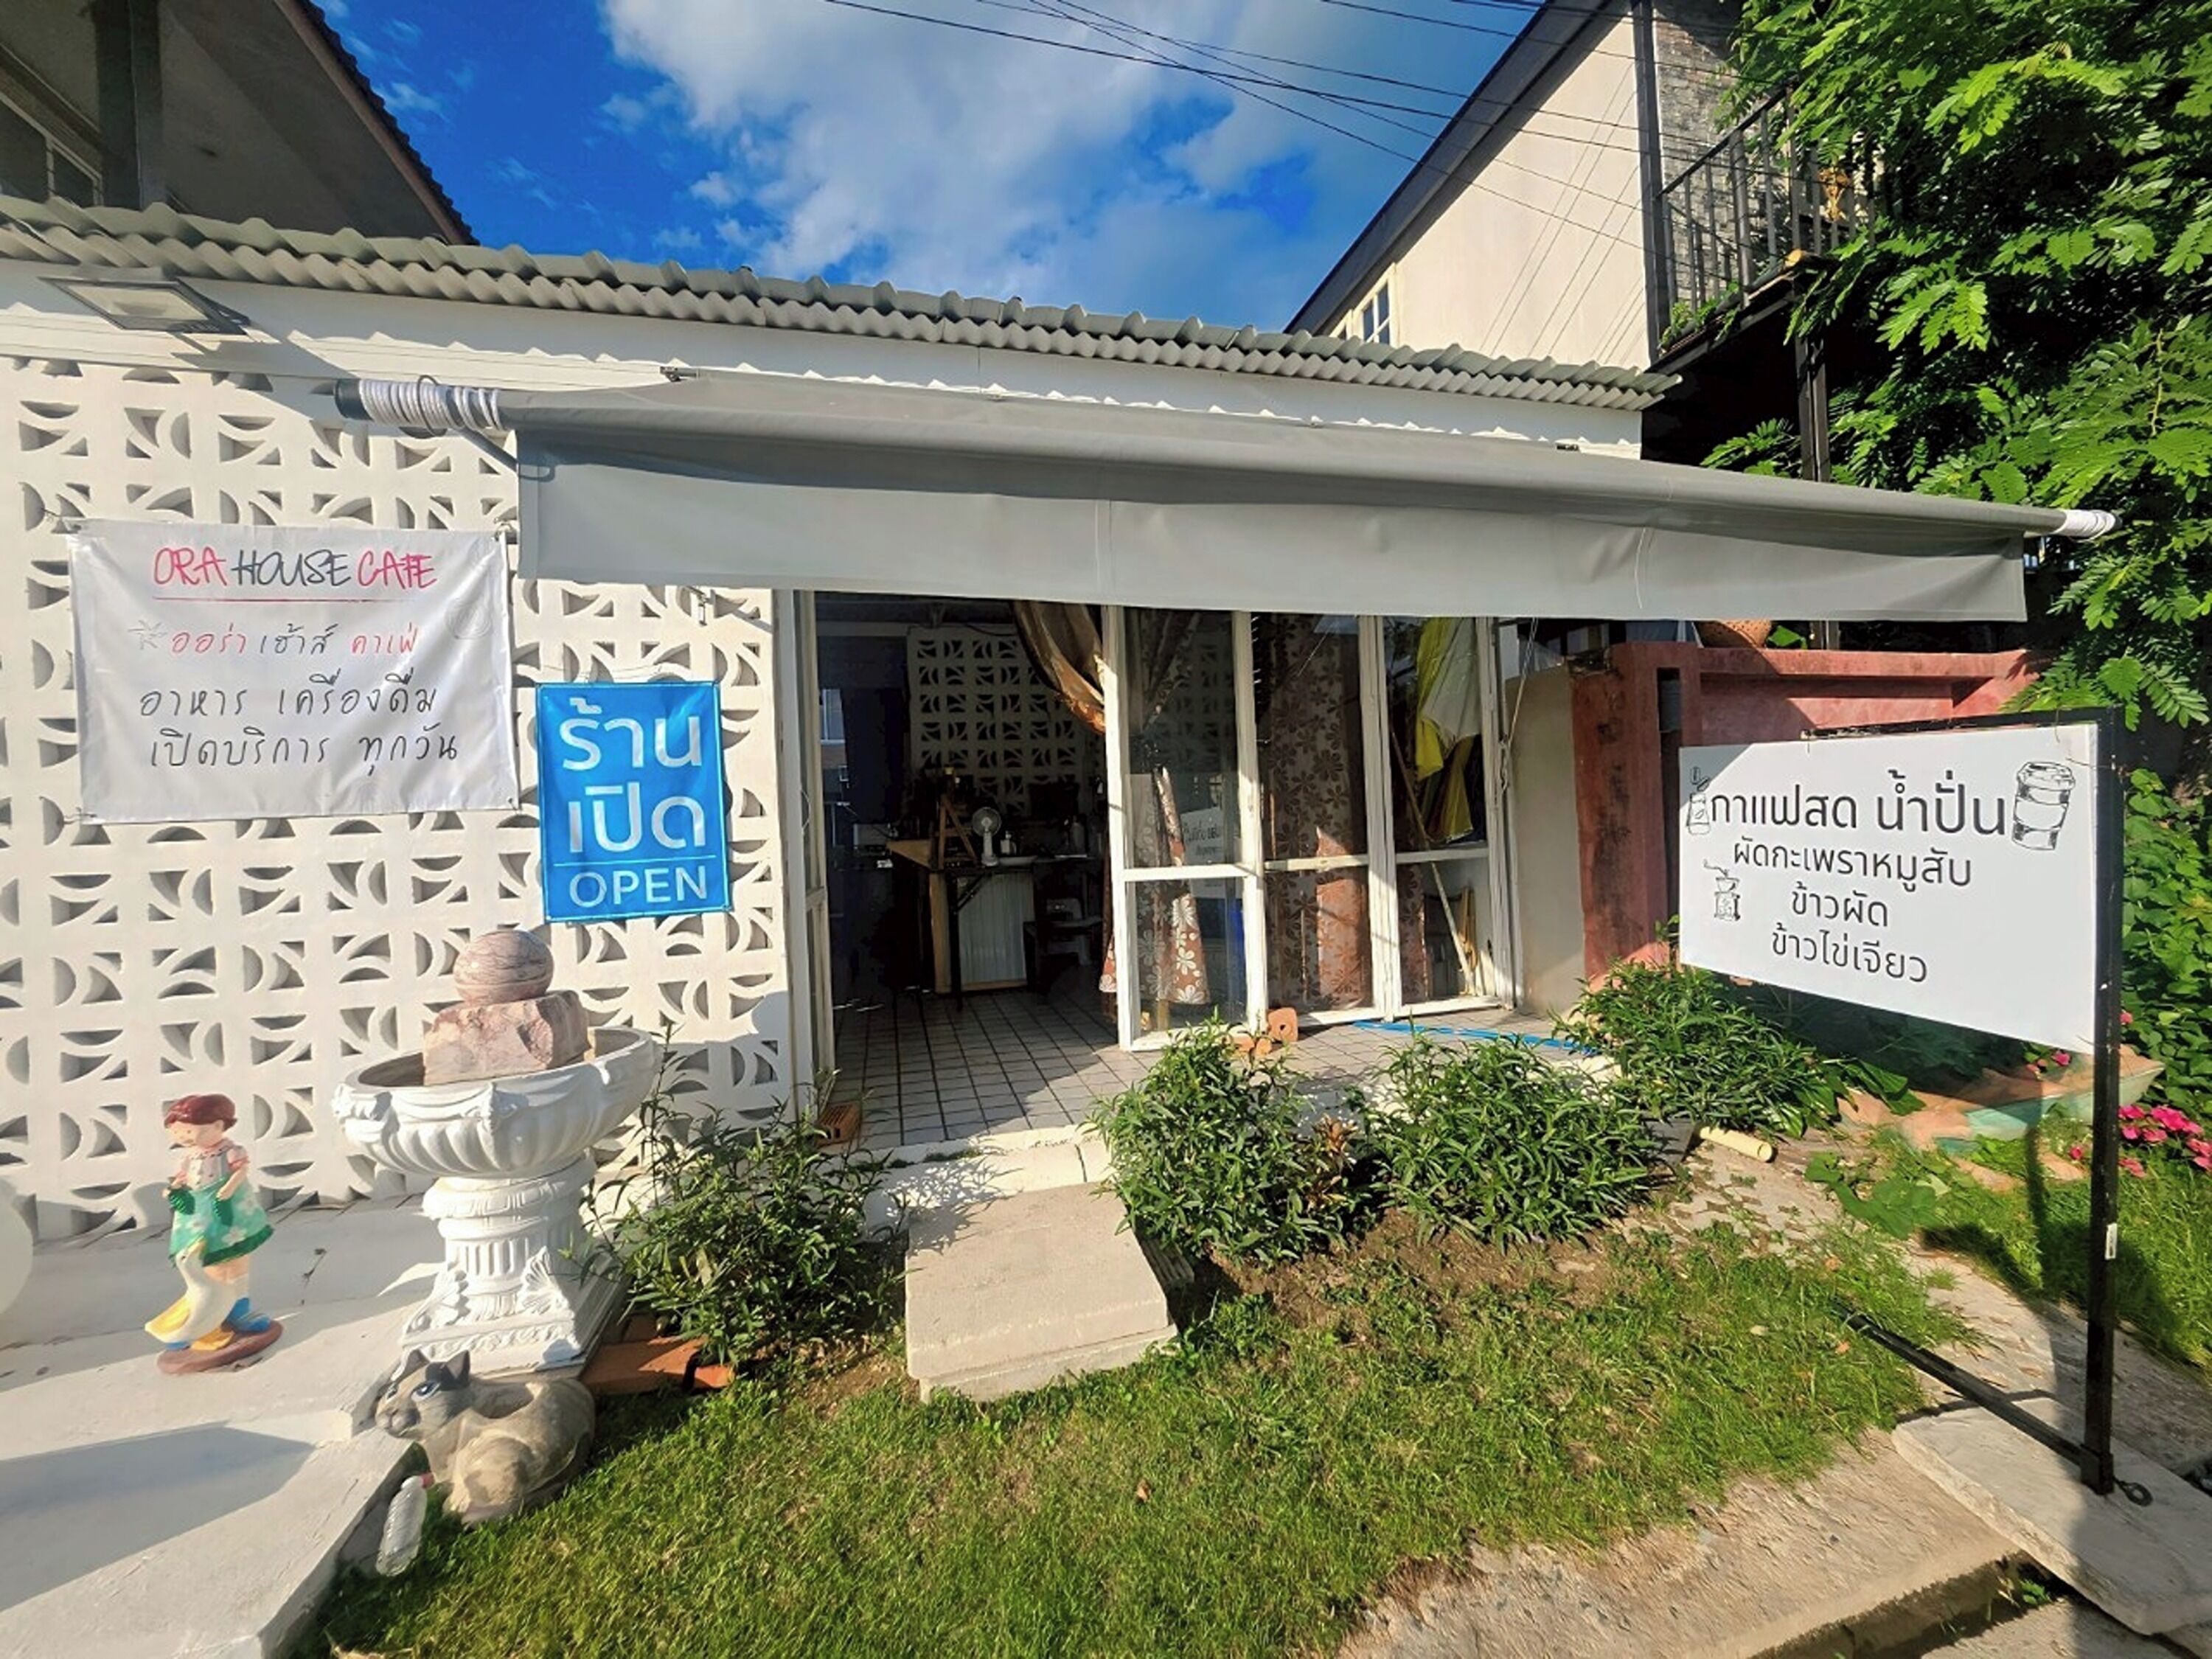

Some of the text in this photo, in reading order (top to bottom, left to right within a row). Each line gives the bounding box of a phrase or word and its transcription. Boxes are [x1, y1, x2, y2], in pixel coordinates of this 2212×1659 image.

[153, 546, 438, 589] ORA HOUSE CAFE
[171, 622, 247, 654] ออร่า
[350, 622, 419, 655] คาเฟ่
[139, 667, 437, 717] อาหาร เครื่องดื่ม
[150, 723, 458, 776] เปิดบริการ ทุกวัน
[559, 697, 702, 771] ร้าน
[568, 781, 706, 853] เปิด
[1711, 769, 2006, 836] กาแฟสด น้ำปั่น
[569, 865, 707, 908] OPEN
[1733, 835, 1972, 893] ผัดกะเพราหมูสับ
[1791, 880, 1888, 928] ข้าวผัด
[1772, 922, 1927, 983] ข้าวไข่เจียว
